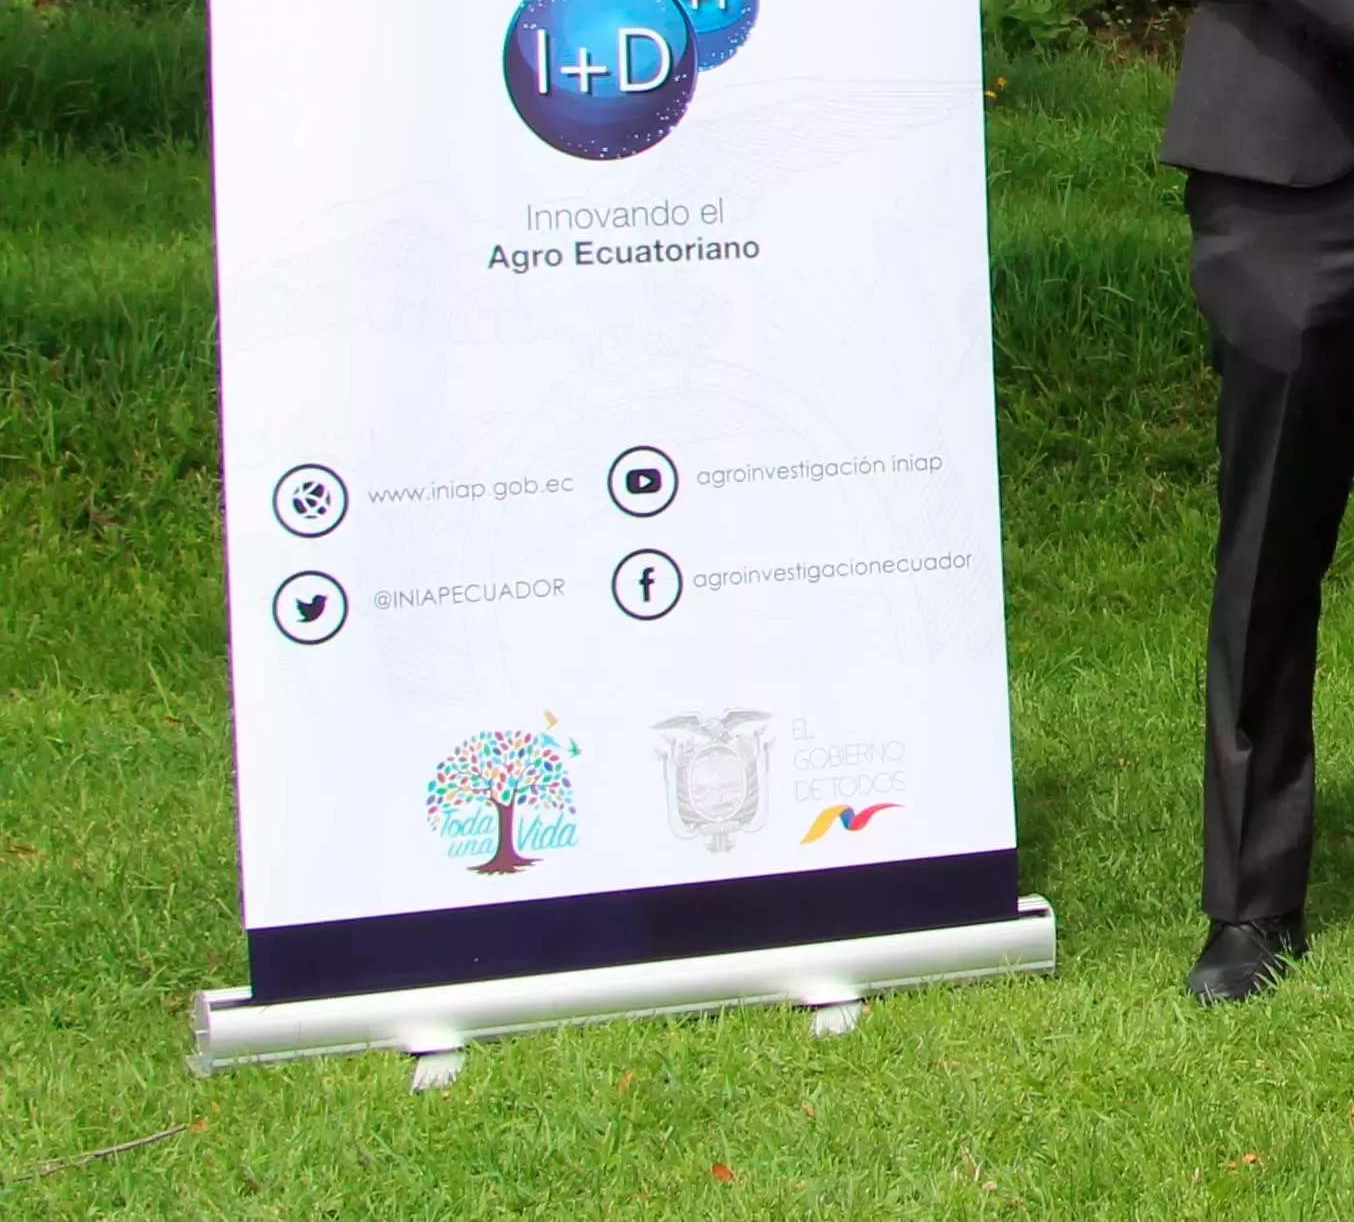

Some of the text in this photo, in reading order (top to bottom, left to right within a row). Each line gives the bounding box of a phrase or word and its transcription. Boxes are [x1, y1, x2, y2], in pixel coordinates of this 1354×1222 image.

[533, 27, 673, 94] I+D
[526, 197, 726, 231] Innovando el
[487, 236, 761, 275] Agro Ecuatoriano
[695, 453, 944, 489] agroinvestigación iniap
[367, 475, 575, 504] www.iniap.gob.ec
[692, 550, 974, 592] agroinvestigacionecuador
[373, 577, 567, 610] @INIAPECUADOR
[791, 718, 815, 740] EL
[793, 740, 906, 771] GOBIERNO
[795, 770, 907, 803] DE TODOS
[440, 806, 579, 851] Toda Vida
[447, 837, 496, 859] una
